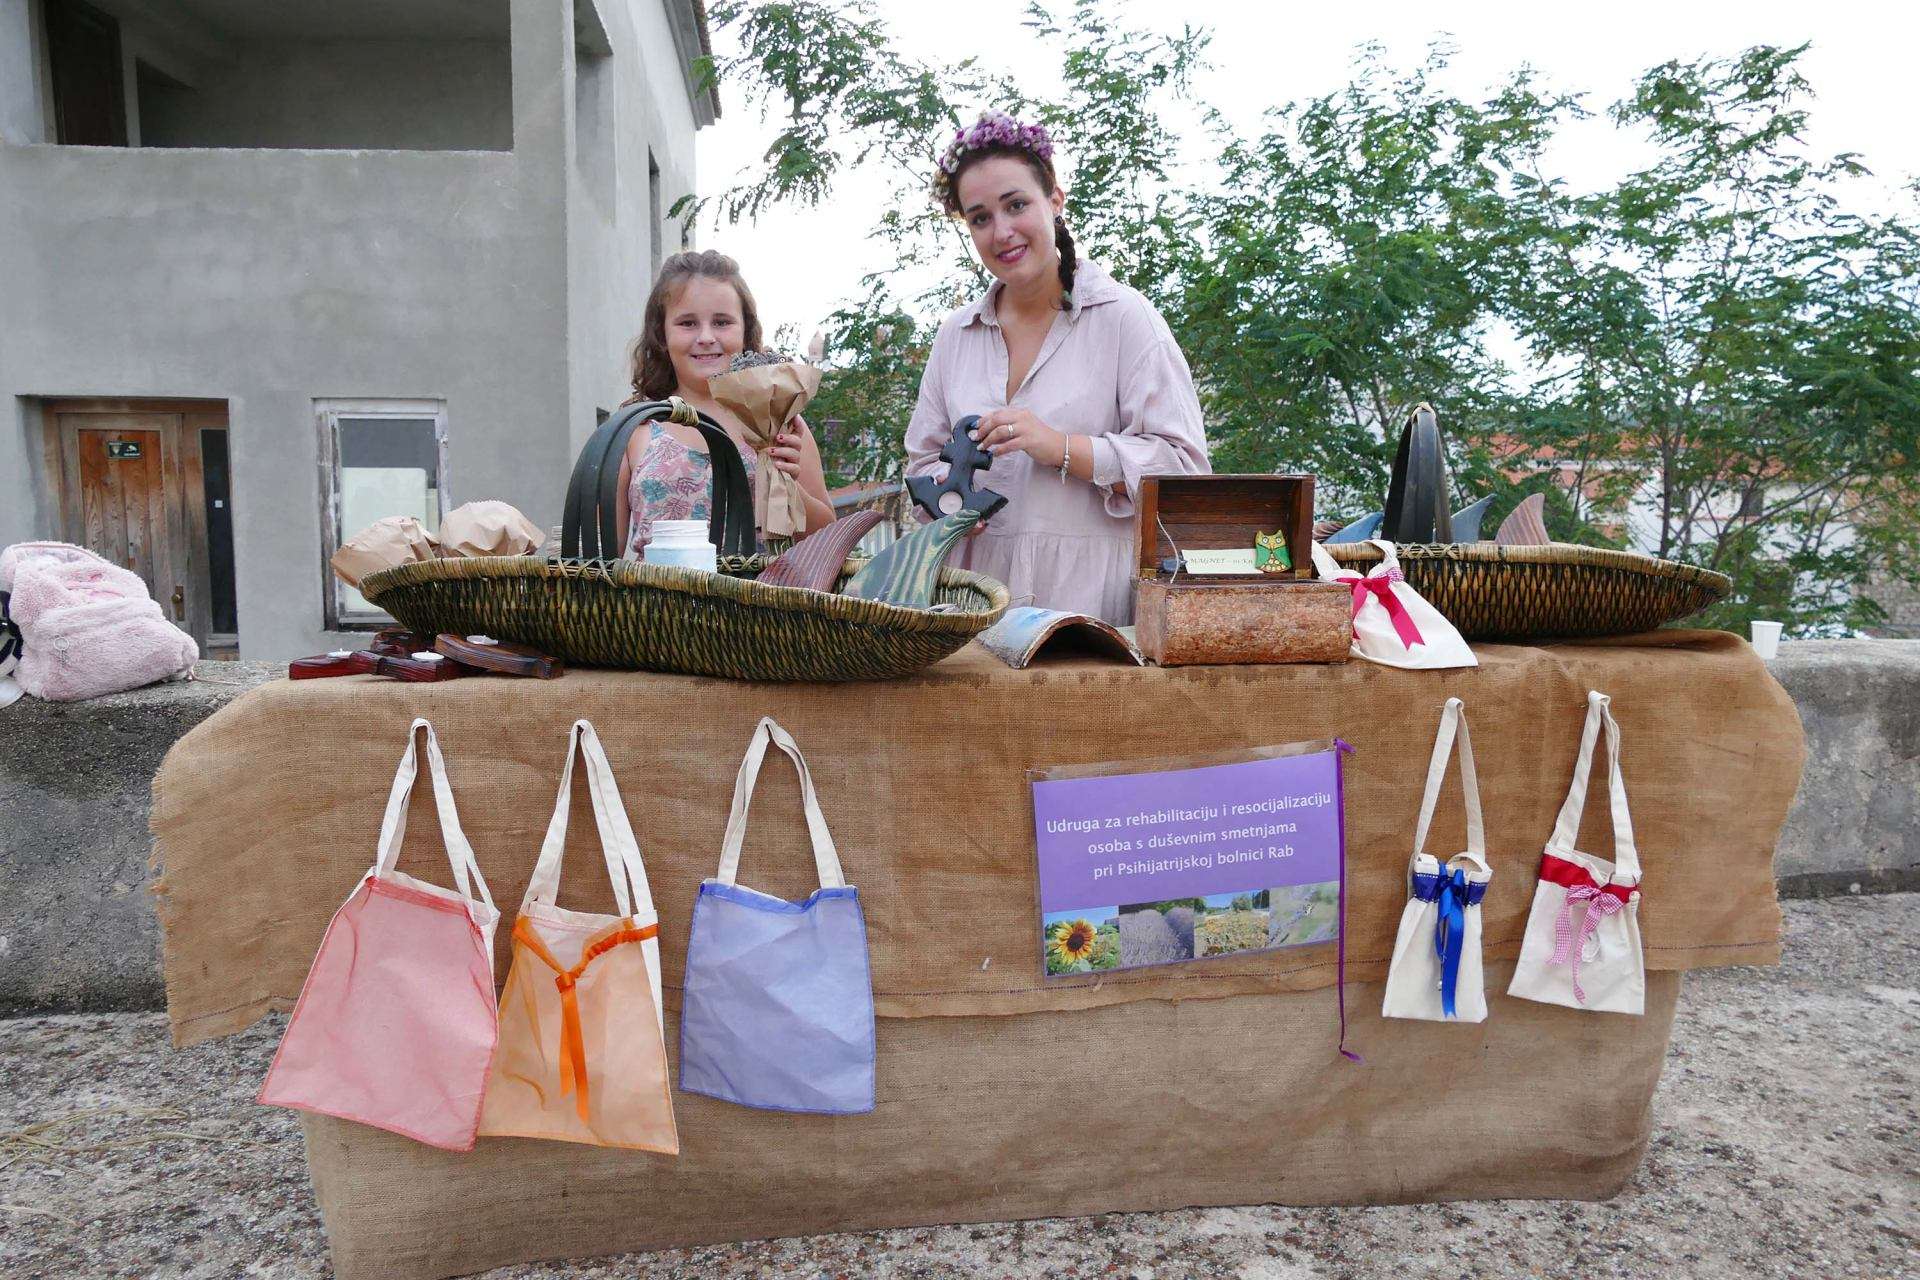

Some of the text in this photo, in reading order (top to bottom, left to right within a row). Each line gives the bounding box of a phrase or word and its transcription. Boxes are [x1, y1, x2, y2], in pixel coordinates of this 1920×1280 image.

[1047, 792, 1331, 833] Udruga za rehabilitaciju i resocijalizaciju
[1088, 822, 1297, 854] osoba s duševnim smetnjama
[1094, 845, 1294, 880] pri Psihijatrijskoj bolnici Rab
